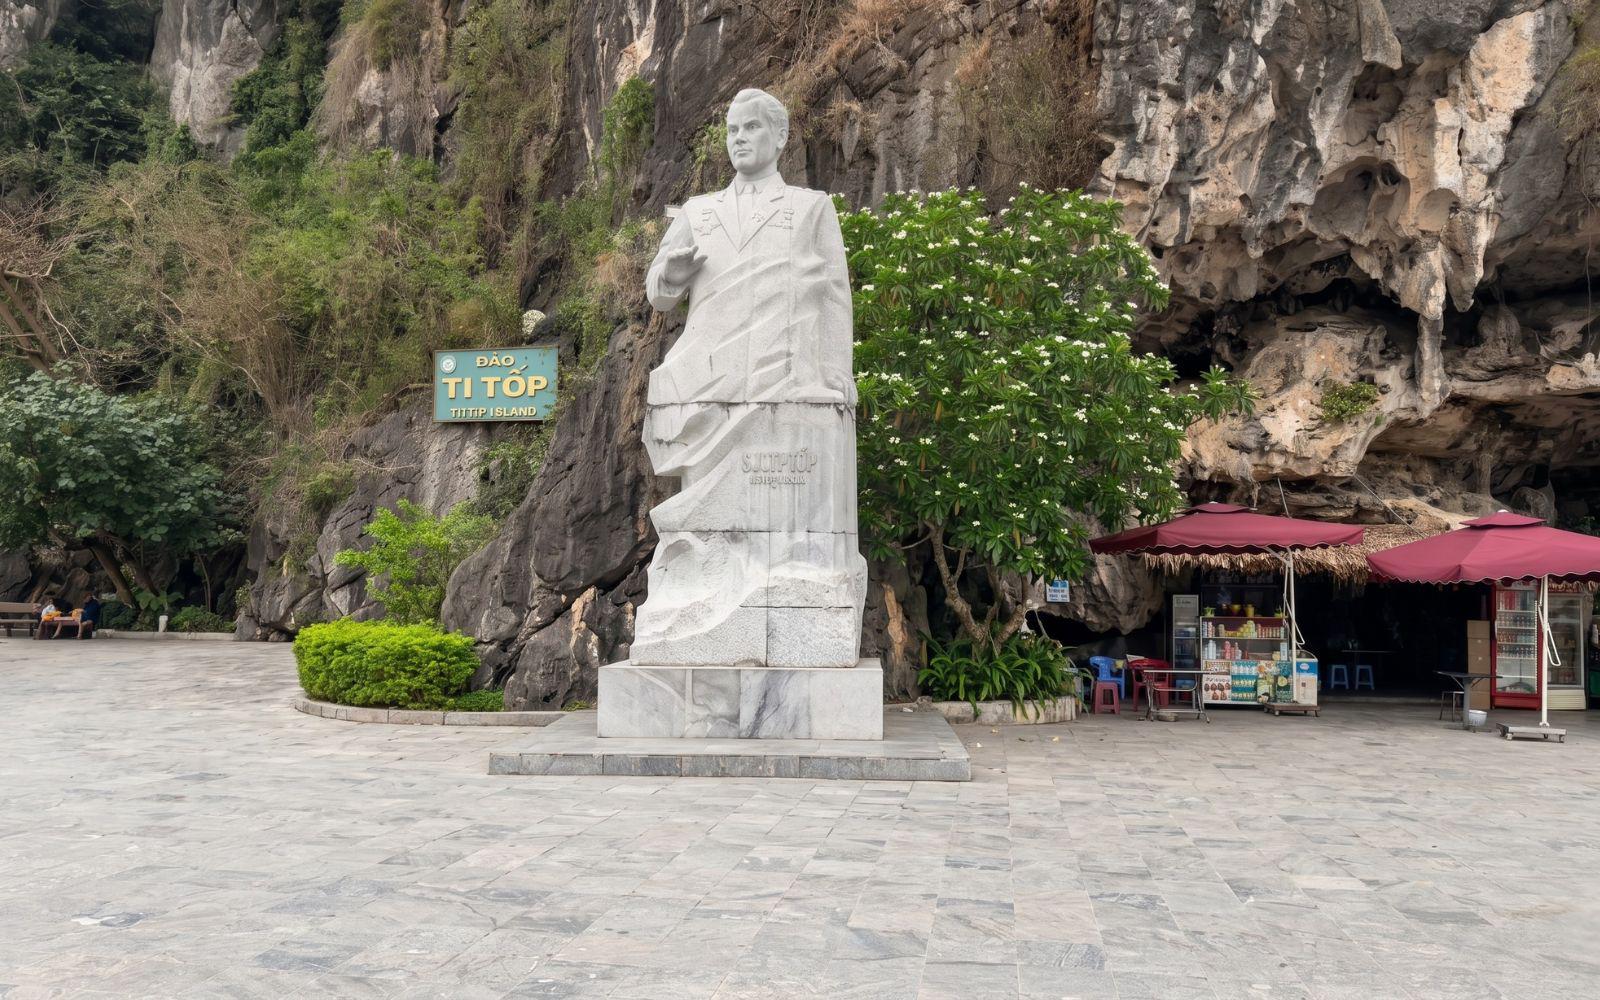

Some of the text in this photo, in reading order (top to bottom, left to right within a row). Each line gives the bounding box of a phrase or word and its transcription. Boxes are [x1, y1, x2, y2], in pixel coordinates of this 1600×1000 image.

[476, 352, 515, 367] ĐẢO
[442, 365, 548, 399] TI TỐP
[490, 406, 537, 417] ISLAND
